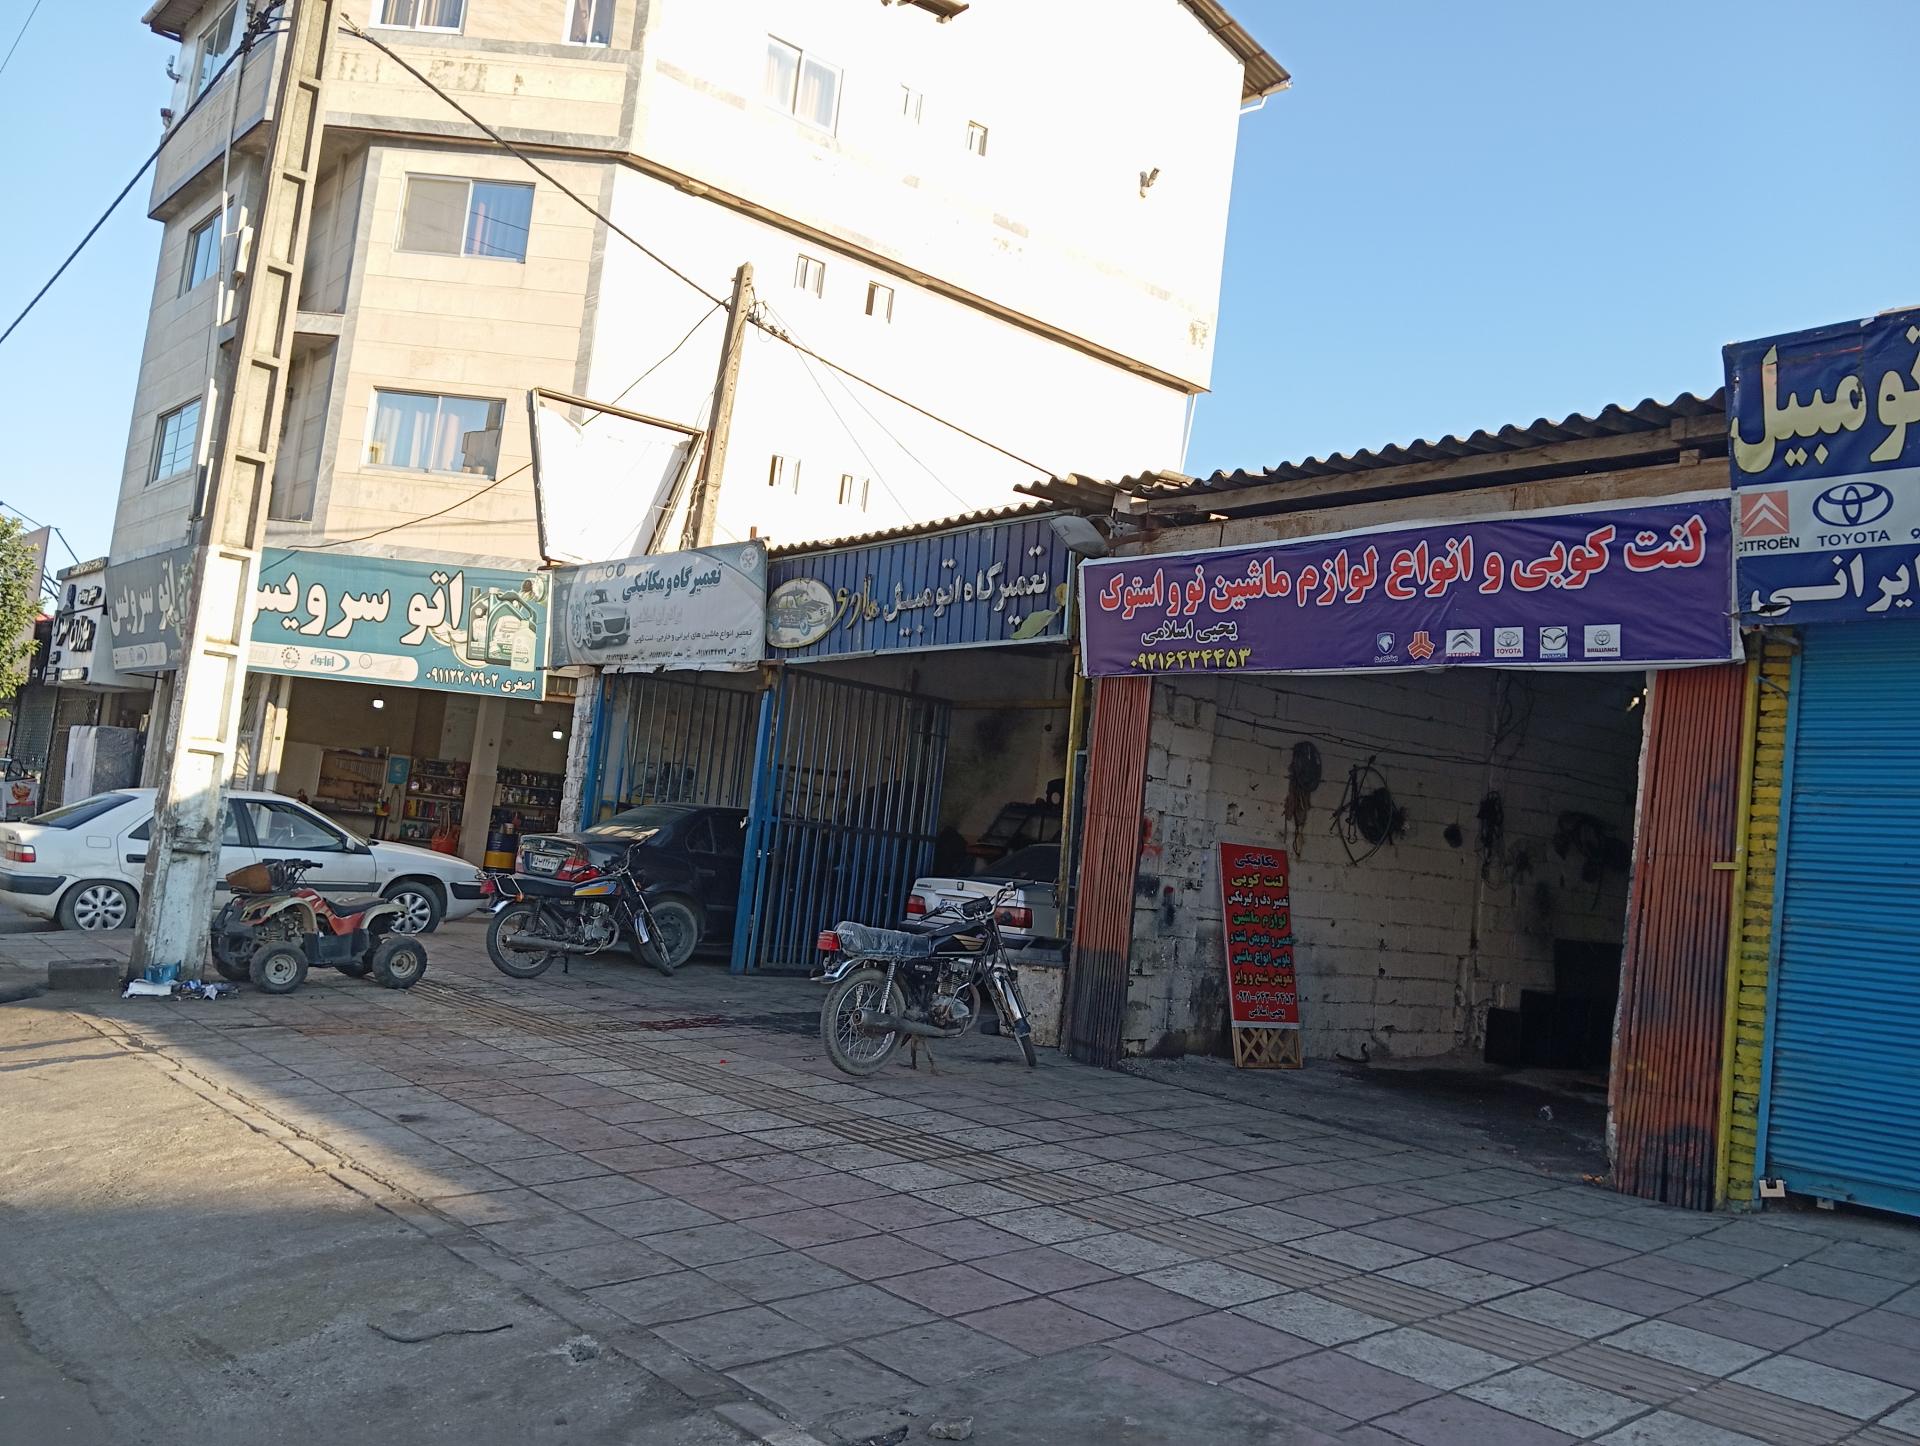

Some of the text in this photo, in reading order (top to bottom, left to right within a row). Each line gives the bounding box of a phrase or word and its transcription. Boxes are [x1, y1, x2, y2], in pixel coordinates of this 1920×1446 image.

[1817, 531, 1890, 547] TOYOTA
[1100, 515, 1707, 620] لنت کوبی و انواع لوازم ماشین نو و استوک
[159, 556, 176, 631] اتو
[622, 568, 665, 602] مکانیکی
[664, 580, 673, 598] و
[884, 559, 961, 636] اتومبیل
[110, 584, 153, 636] سرویس
[400, 570, 464, 646] اتو
[1141, 618, 1238, 647] یحیی اسلامی
[500, 675, 537, 693] اصغری
[1234, 853, 1279, 869] مکانیکی
[1231, 873, 1284, 888] لنت کوبی
[1272, 896, 1289, 909] تعمیر
[1233, 910, 1287, 929] لوازم ماشین
[1254, 952, 1271, 966] انواع
